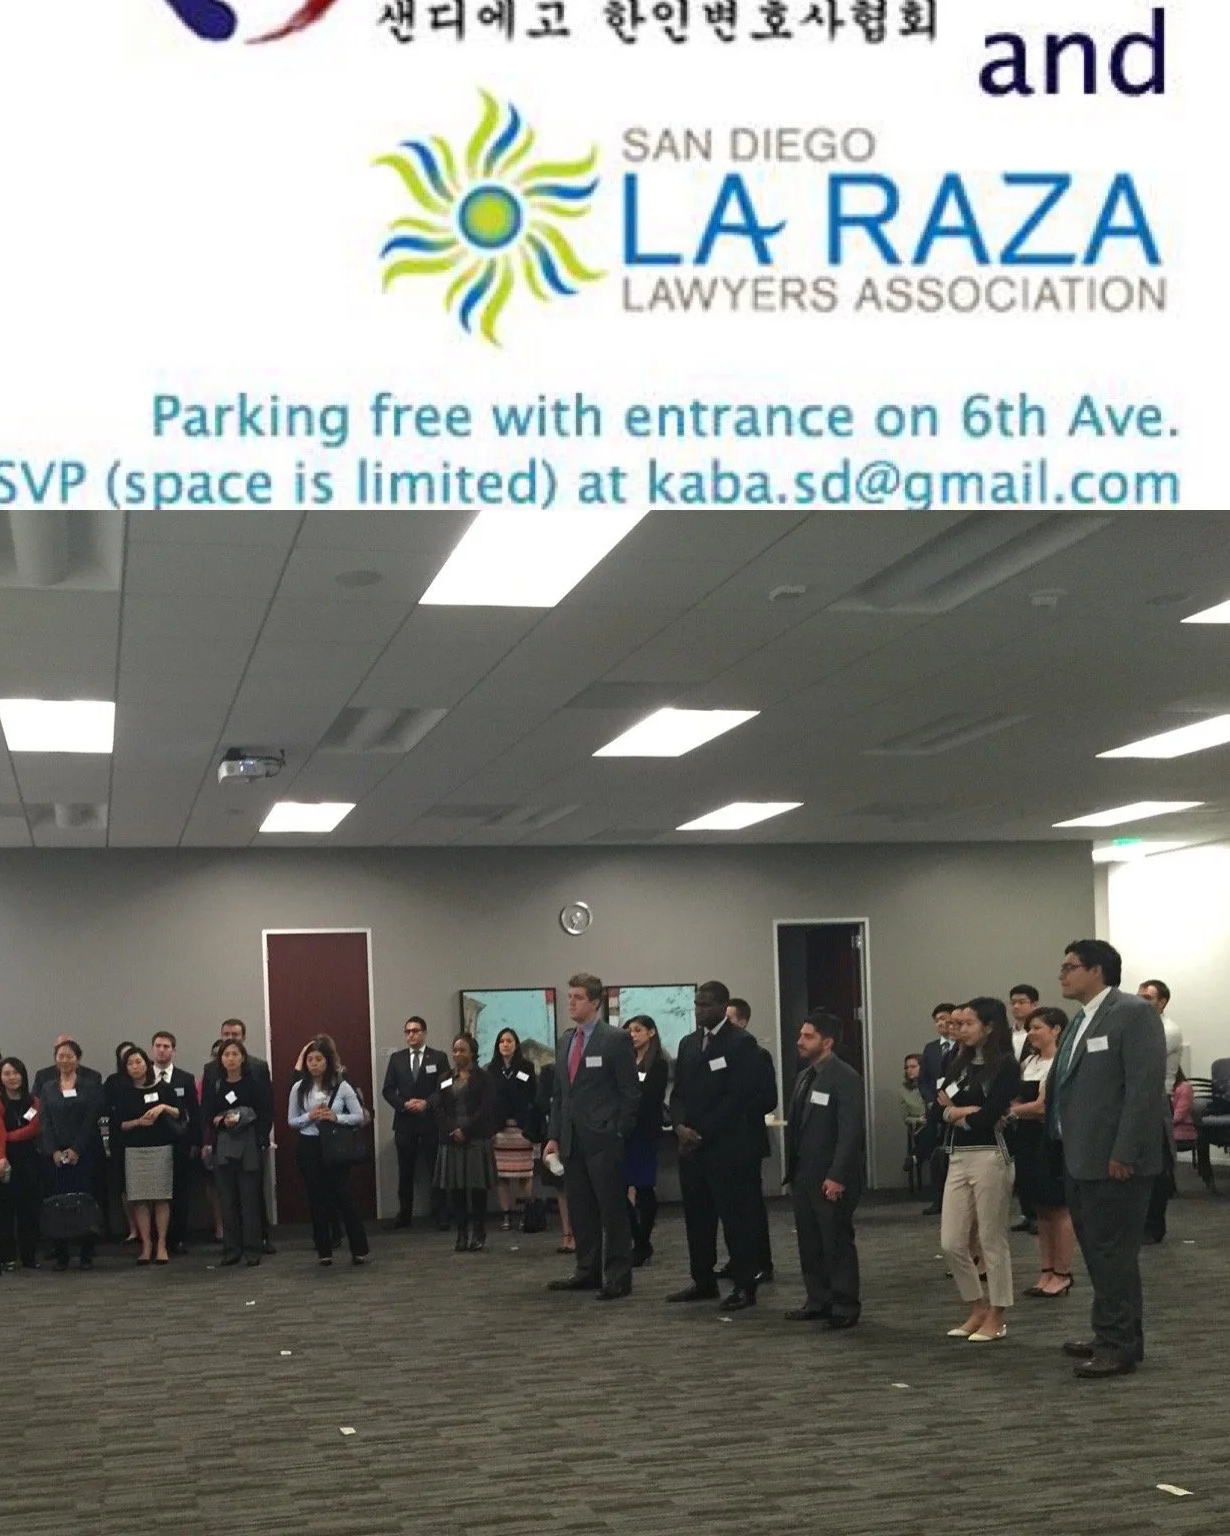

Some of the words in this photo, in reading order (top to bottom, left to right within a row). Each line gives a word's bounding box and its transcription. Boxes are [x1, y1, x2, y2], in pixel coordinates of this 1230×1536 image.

[978, 6, 1165, 98] and
[625, 129, 712, 160] SAN
[732, 128, 875, 162] DIEGO
[623, 172, 786, 267] LA
[827, 171, 1162, 268] RAZA
[624, 278, 836, 310] LAWYERS
[857, 278, 1165, 312] ASSOCIATION
[153, 392, 349, 449] Parking
[370, 392, 471, 438] free
[492, 392, 601, 438] with
[625, 400, 853, 438] entrance
[875, 404, 938, 438] on
[962, 392, 1045, 438] 6th
[1068, 394, 1177, 438] Ave.
[107, 460, 272, 511] (space
[295, 461, 333, 505] is
[358, 457, 557, 510] limited)
[578, 466, 627, 504] at
[648, 458, 1179, 511] kaba.sd@gmail.com
